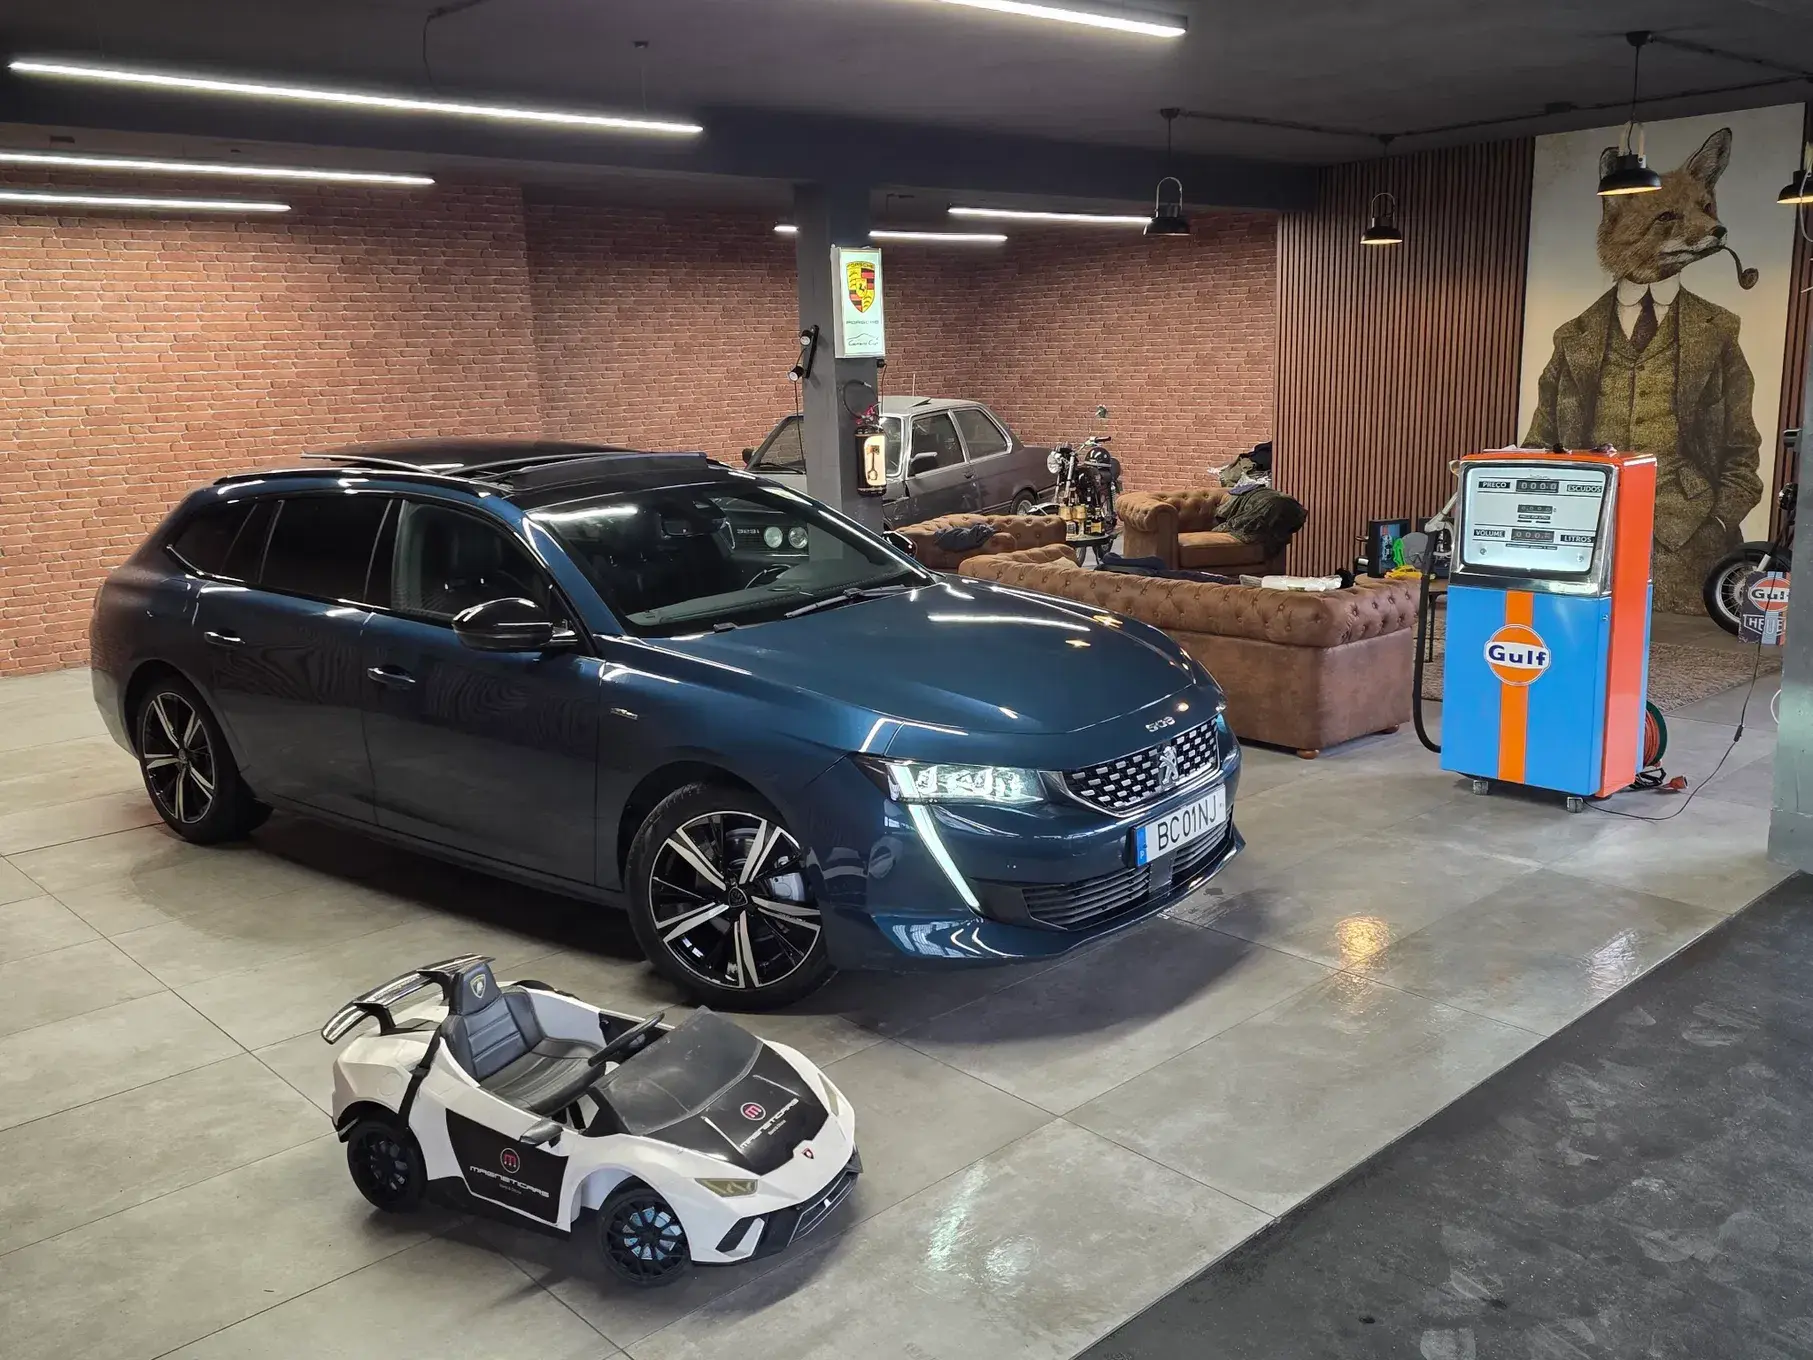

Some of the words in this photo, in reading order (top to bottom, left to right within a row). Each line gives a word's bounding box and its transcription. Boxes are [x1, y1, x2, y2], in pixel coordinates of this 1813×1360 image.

[1482, 481, 1507, 489] PREÇO
[1567, 485, 1602, 493] ESCUDOS
[1475, 529, 1505, 537] VOLUME
[1564, 535, 1592, 543] LITROS
[1751, 588, 1789, 600] Gul
[1749, 617, 1787, 634] HEUE
[1488, 644, 1547, 666] Gulf
[1145, 716, 1176, 733] 508
